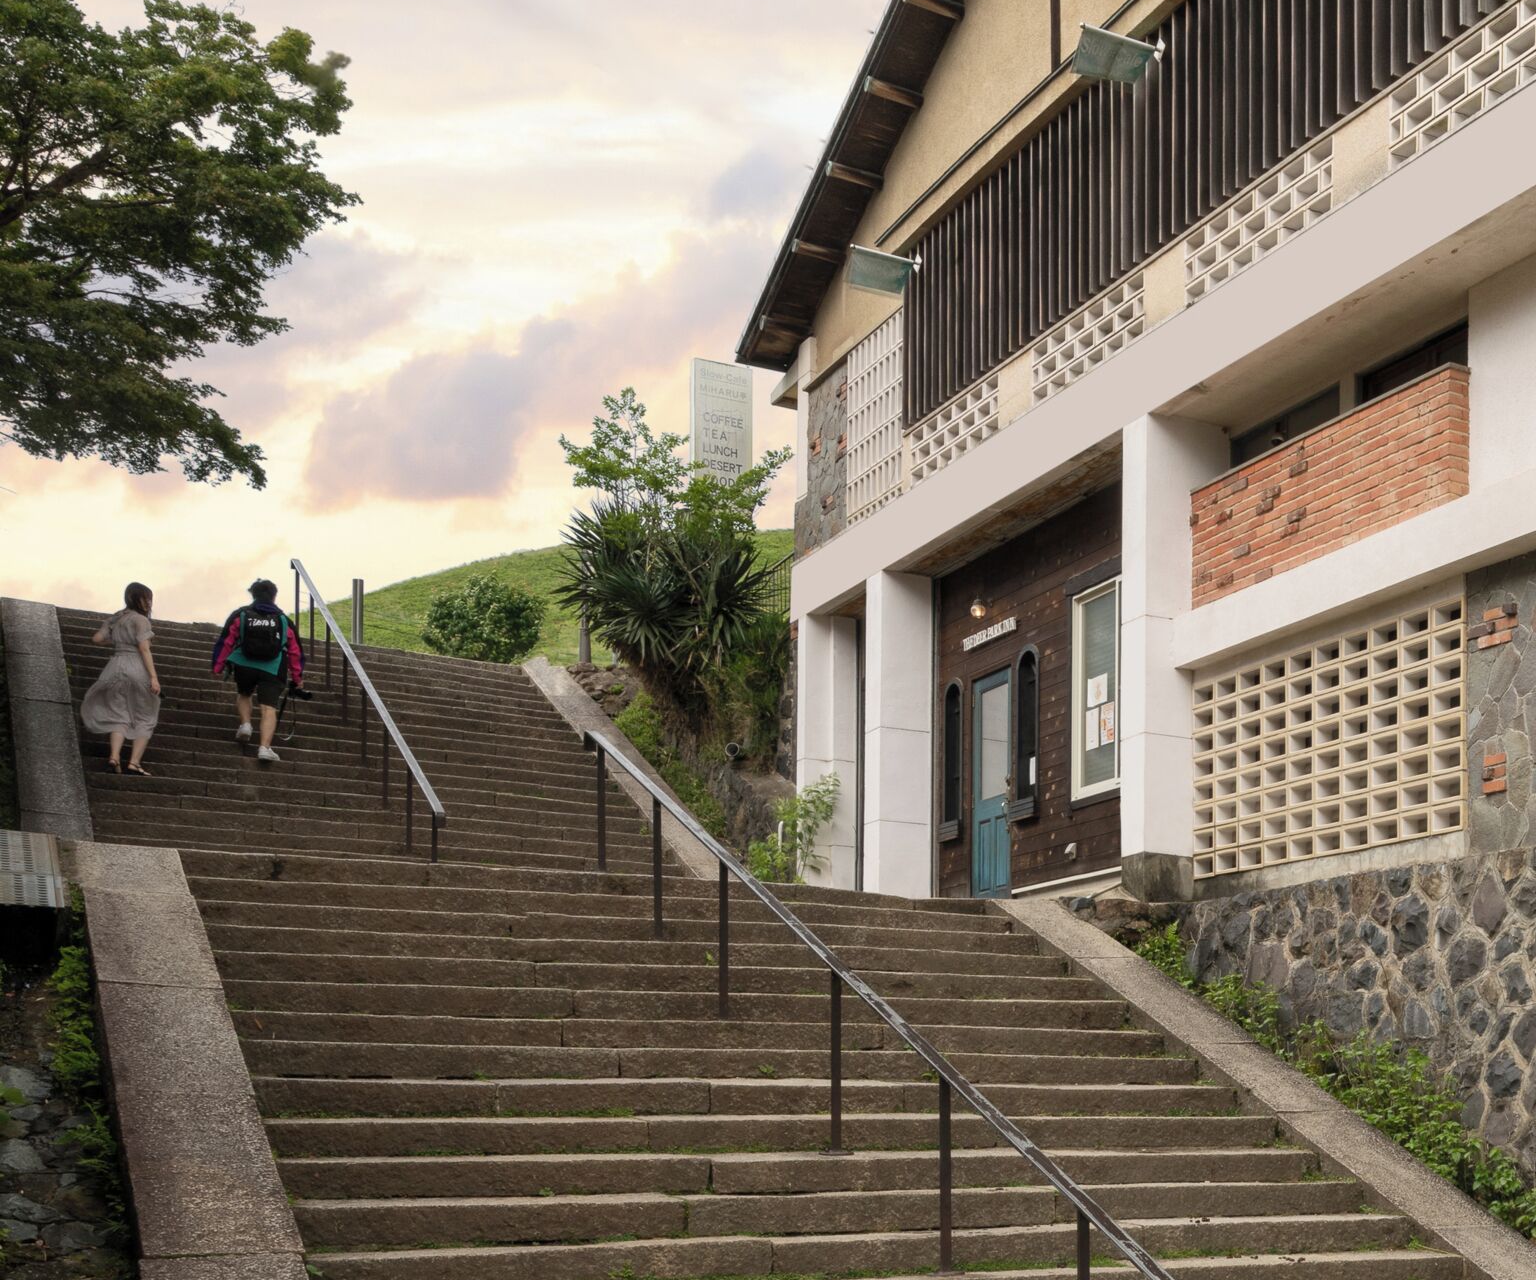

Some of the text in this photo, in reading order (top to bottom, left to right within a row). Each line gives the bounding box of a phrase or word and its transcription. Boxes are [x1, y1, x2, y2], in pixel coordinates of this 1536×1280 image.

[703, 412, 744, 429] COFFEE
[703, 427, 728, 441] TEA
[702, 442, 738, 459] LUNCH
[702, 458, 743, 474] DESERT
